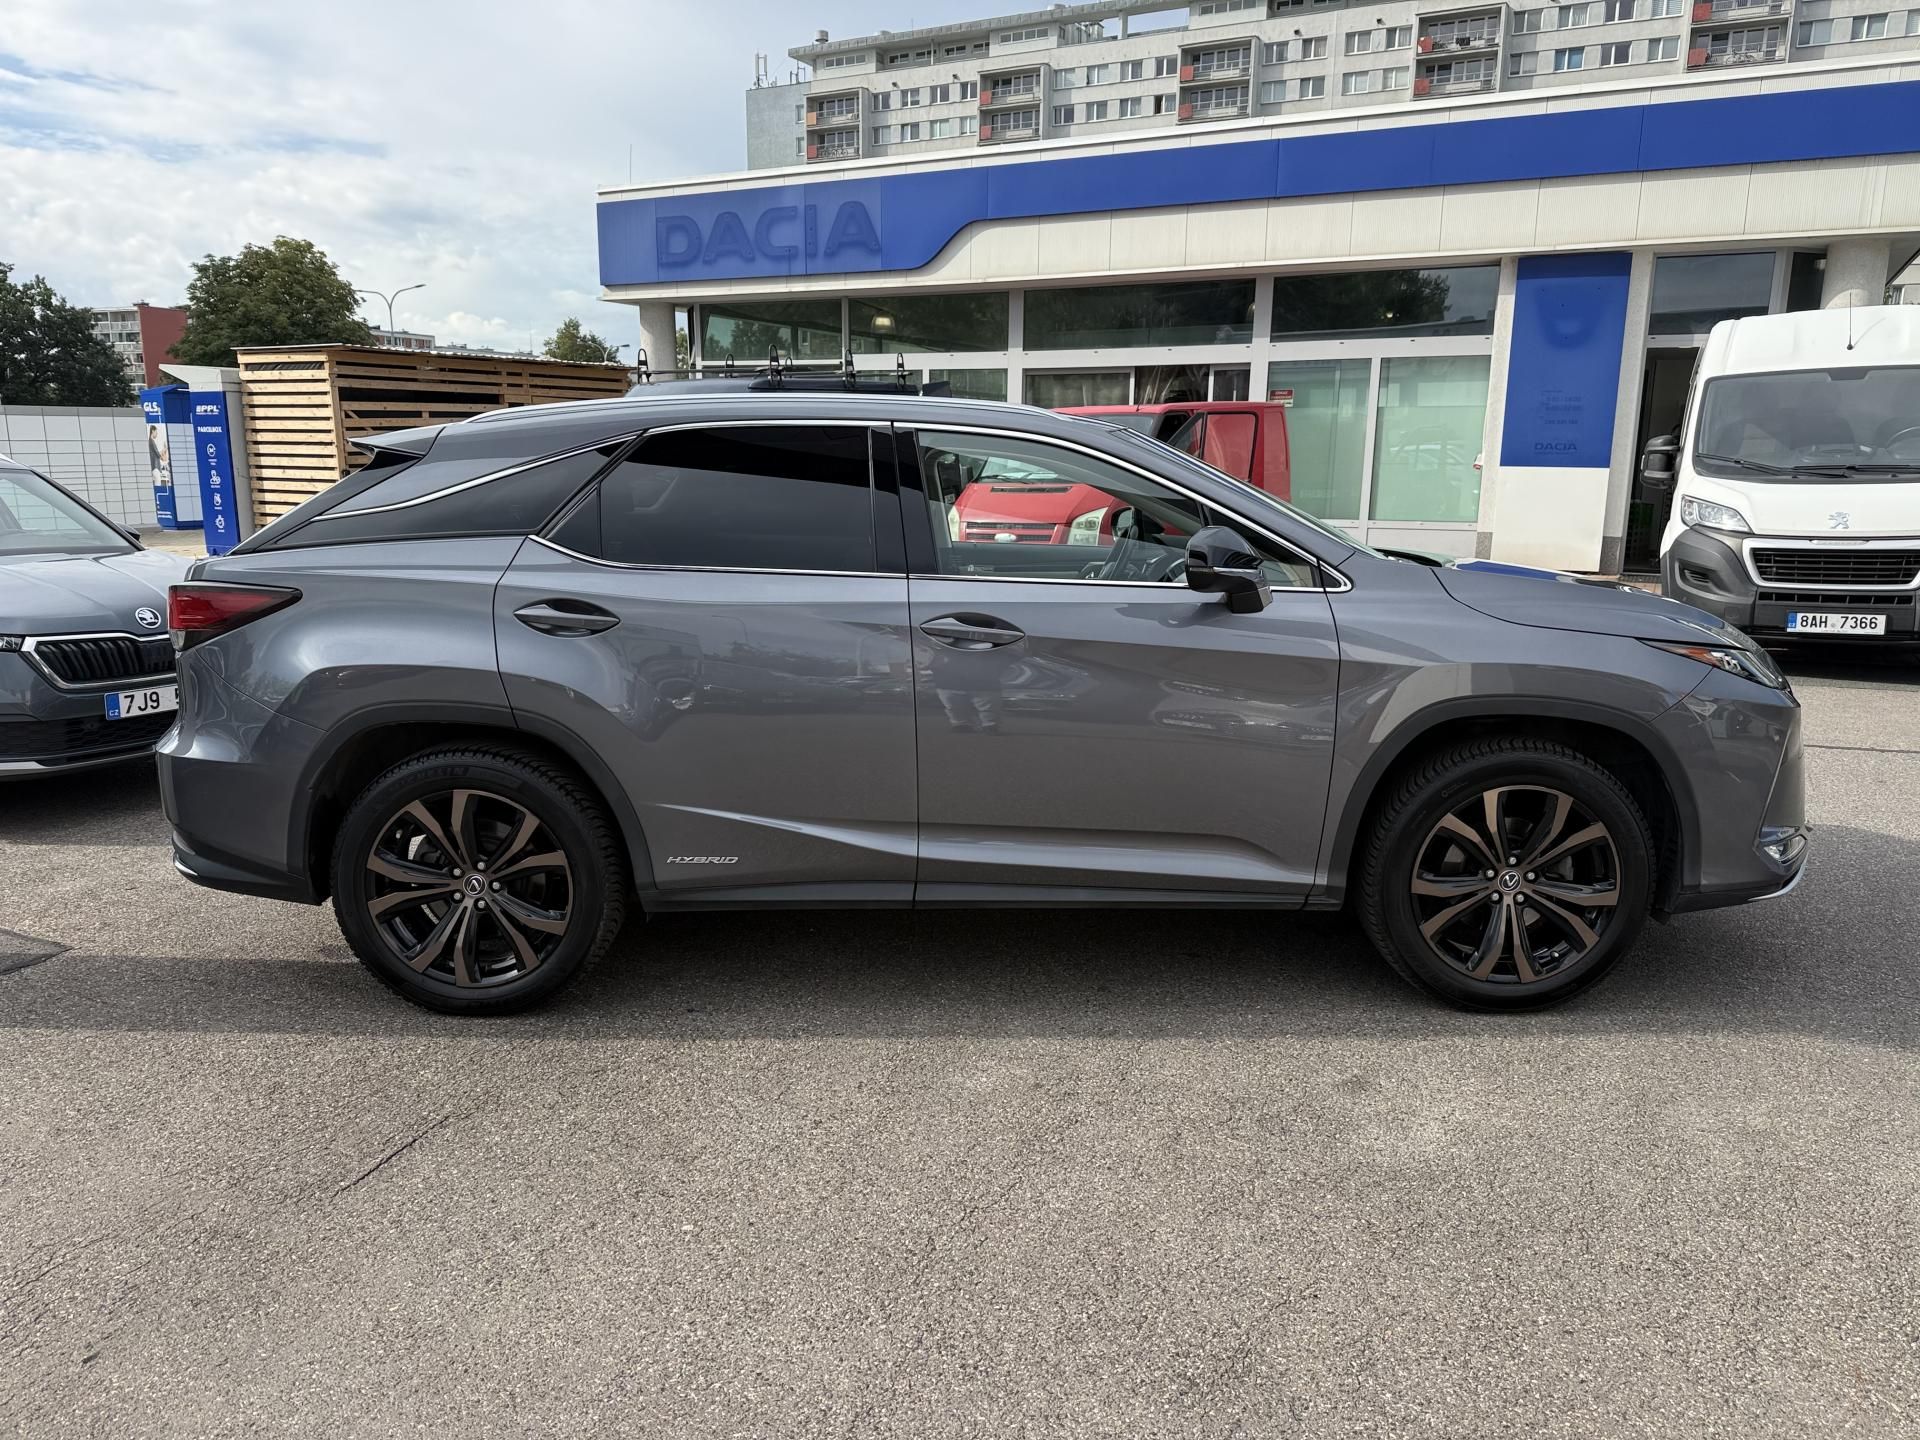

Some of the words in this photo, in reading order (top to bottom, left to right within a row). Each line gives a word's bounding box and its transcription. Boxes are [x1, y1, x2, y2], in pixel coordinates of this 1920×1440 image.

[656, 200, 881, 267] DACIA
[143, 401, 158, 412] GLS
[1534, 442, 1577, 450] DACIA
[1800, 615, 1828, 629] 8AH
[1840, 616, 1878, 630] 7366
[123, 691, 160, 714] 7J9
[666, 856, 739, 864] HYBRID
